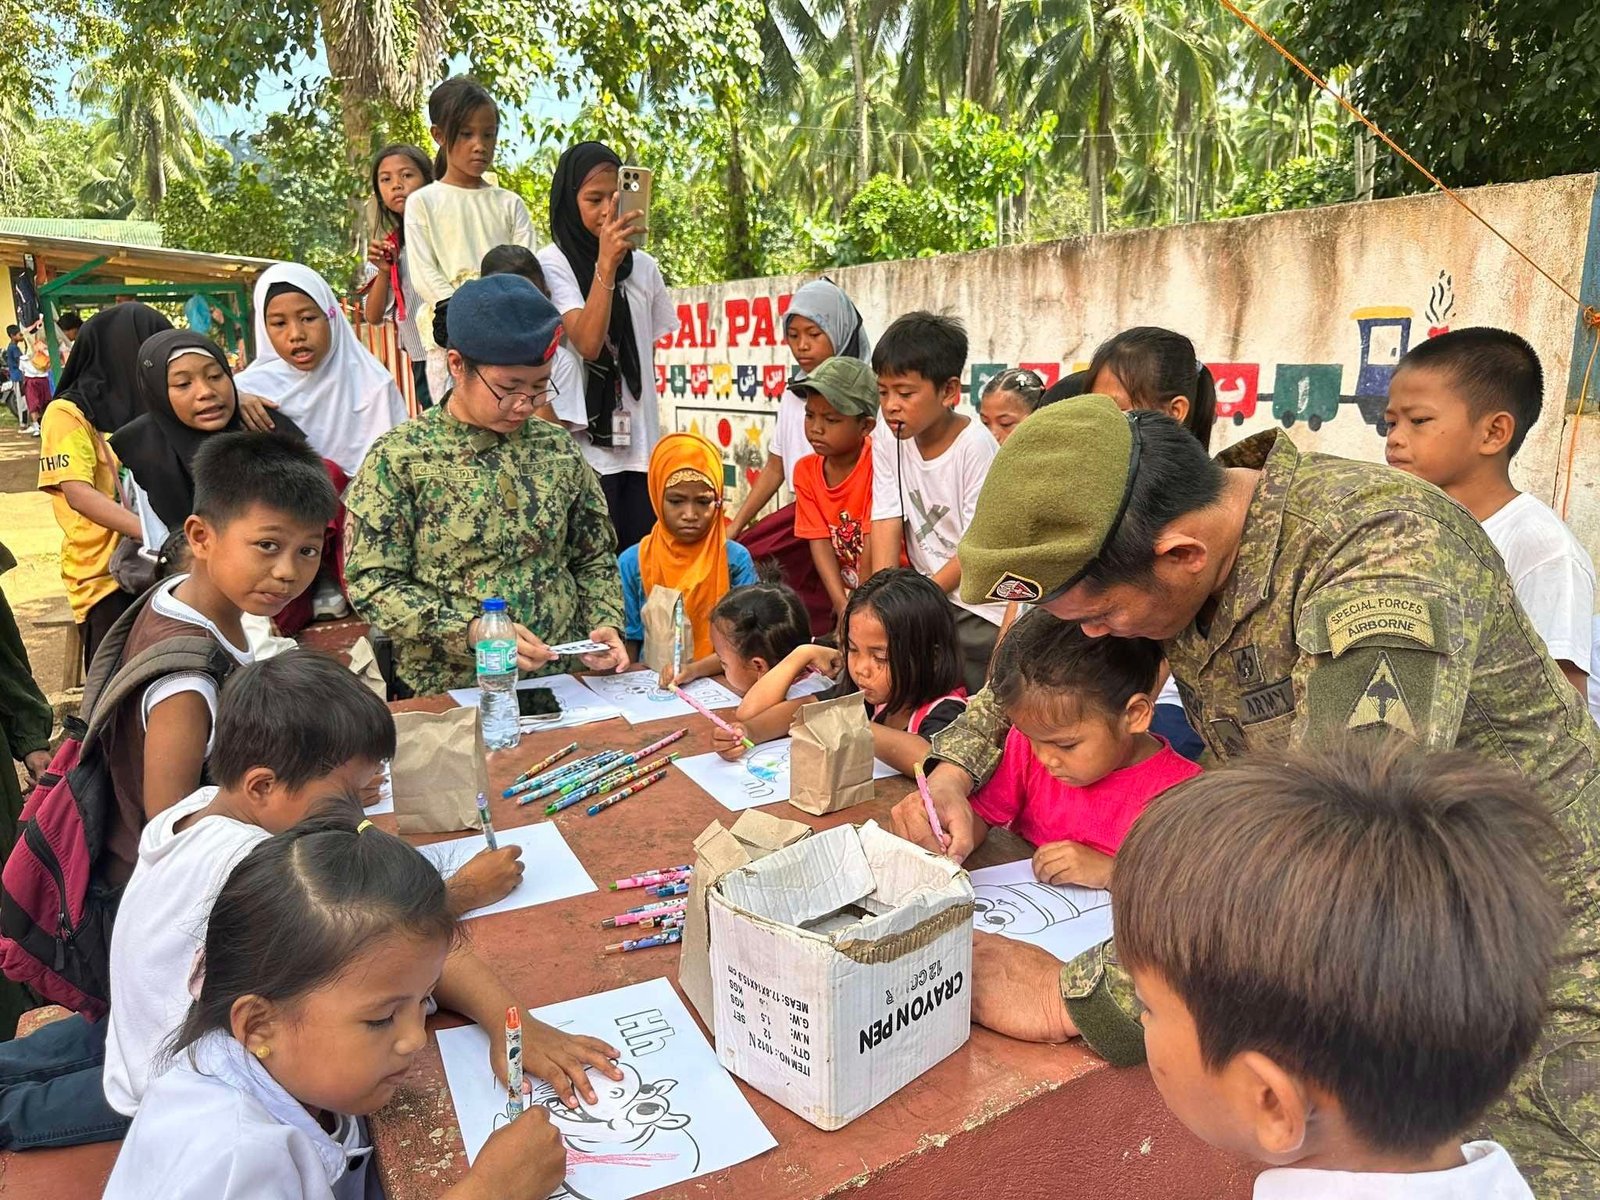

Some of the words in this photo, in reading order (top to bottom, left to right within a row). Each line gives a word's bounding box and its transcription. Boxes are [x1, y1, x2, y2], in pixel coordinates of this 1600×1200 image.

[1330, 601, 1376, 625] SPECIAL
[1378, 598, 1424, 615] FORCES
[1348, 618, 1417, 637] AIRBORNE
[1246, 688, 1290, 717] ARMY
[729, 979, 743, 995] KGS
[730, 994, 745, 1009] KGS
[781, 994, 809, 1014] MEAS:
[896, 971, 963, 1032] CRAYON
[733, 1009, 746, 1024] SET
[760, 1012, 771, 1025] 1.5
[789, 1012, 809, 1029] G.W:
[614, 1008, 676, 1057] Hh
[763, 1028, 772, 1040] 12
[790, 1028, 810, 1045] N.W:
[859, 1013, 893, 1055] PEN
[757, 1038, 773, 1055] 1012
[790, 1044, 810, 1061] QTY:
[790, 1059, 811, 1077] ITEM
